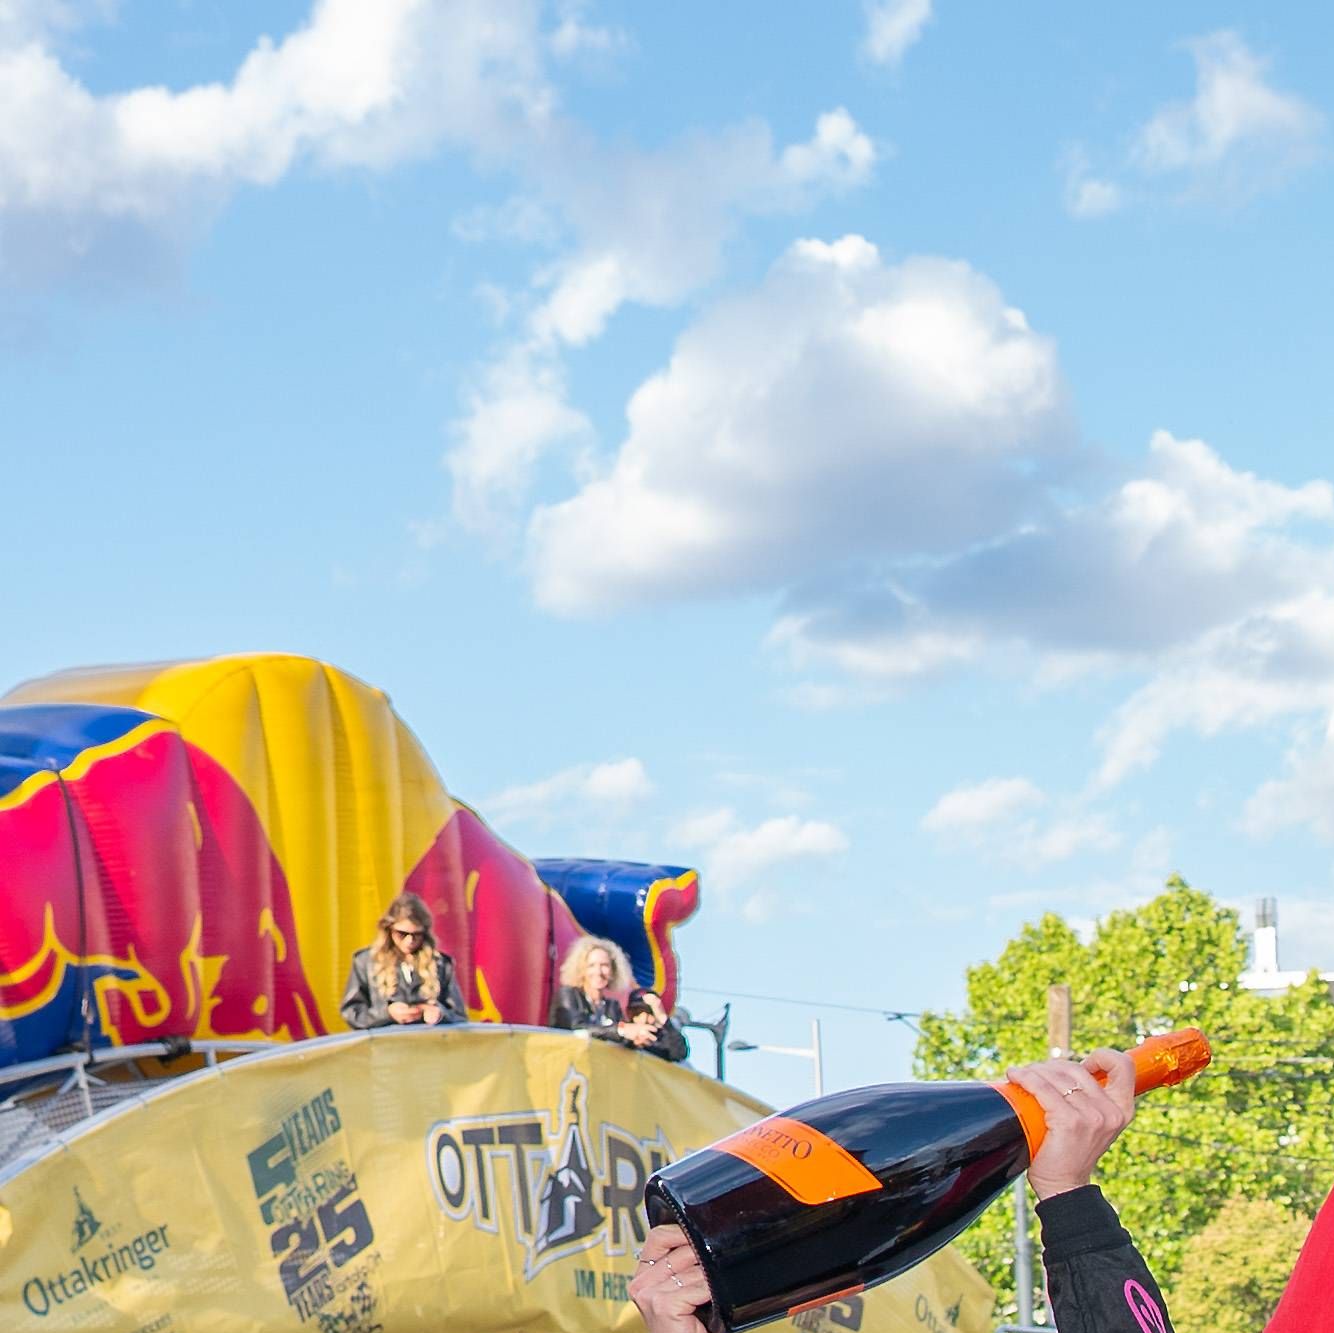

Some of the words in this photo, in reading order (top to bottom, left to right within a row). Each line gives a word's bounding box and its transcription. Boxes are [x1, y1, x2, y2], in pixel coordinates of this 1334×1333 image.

[282, 1087, 342, 1161] YEARS
[22, 1223, 171, 1317] Ottakringer
[575, 1269, 596, 1299] IM
